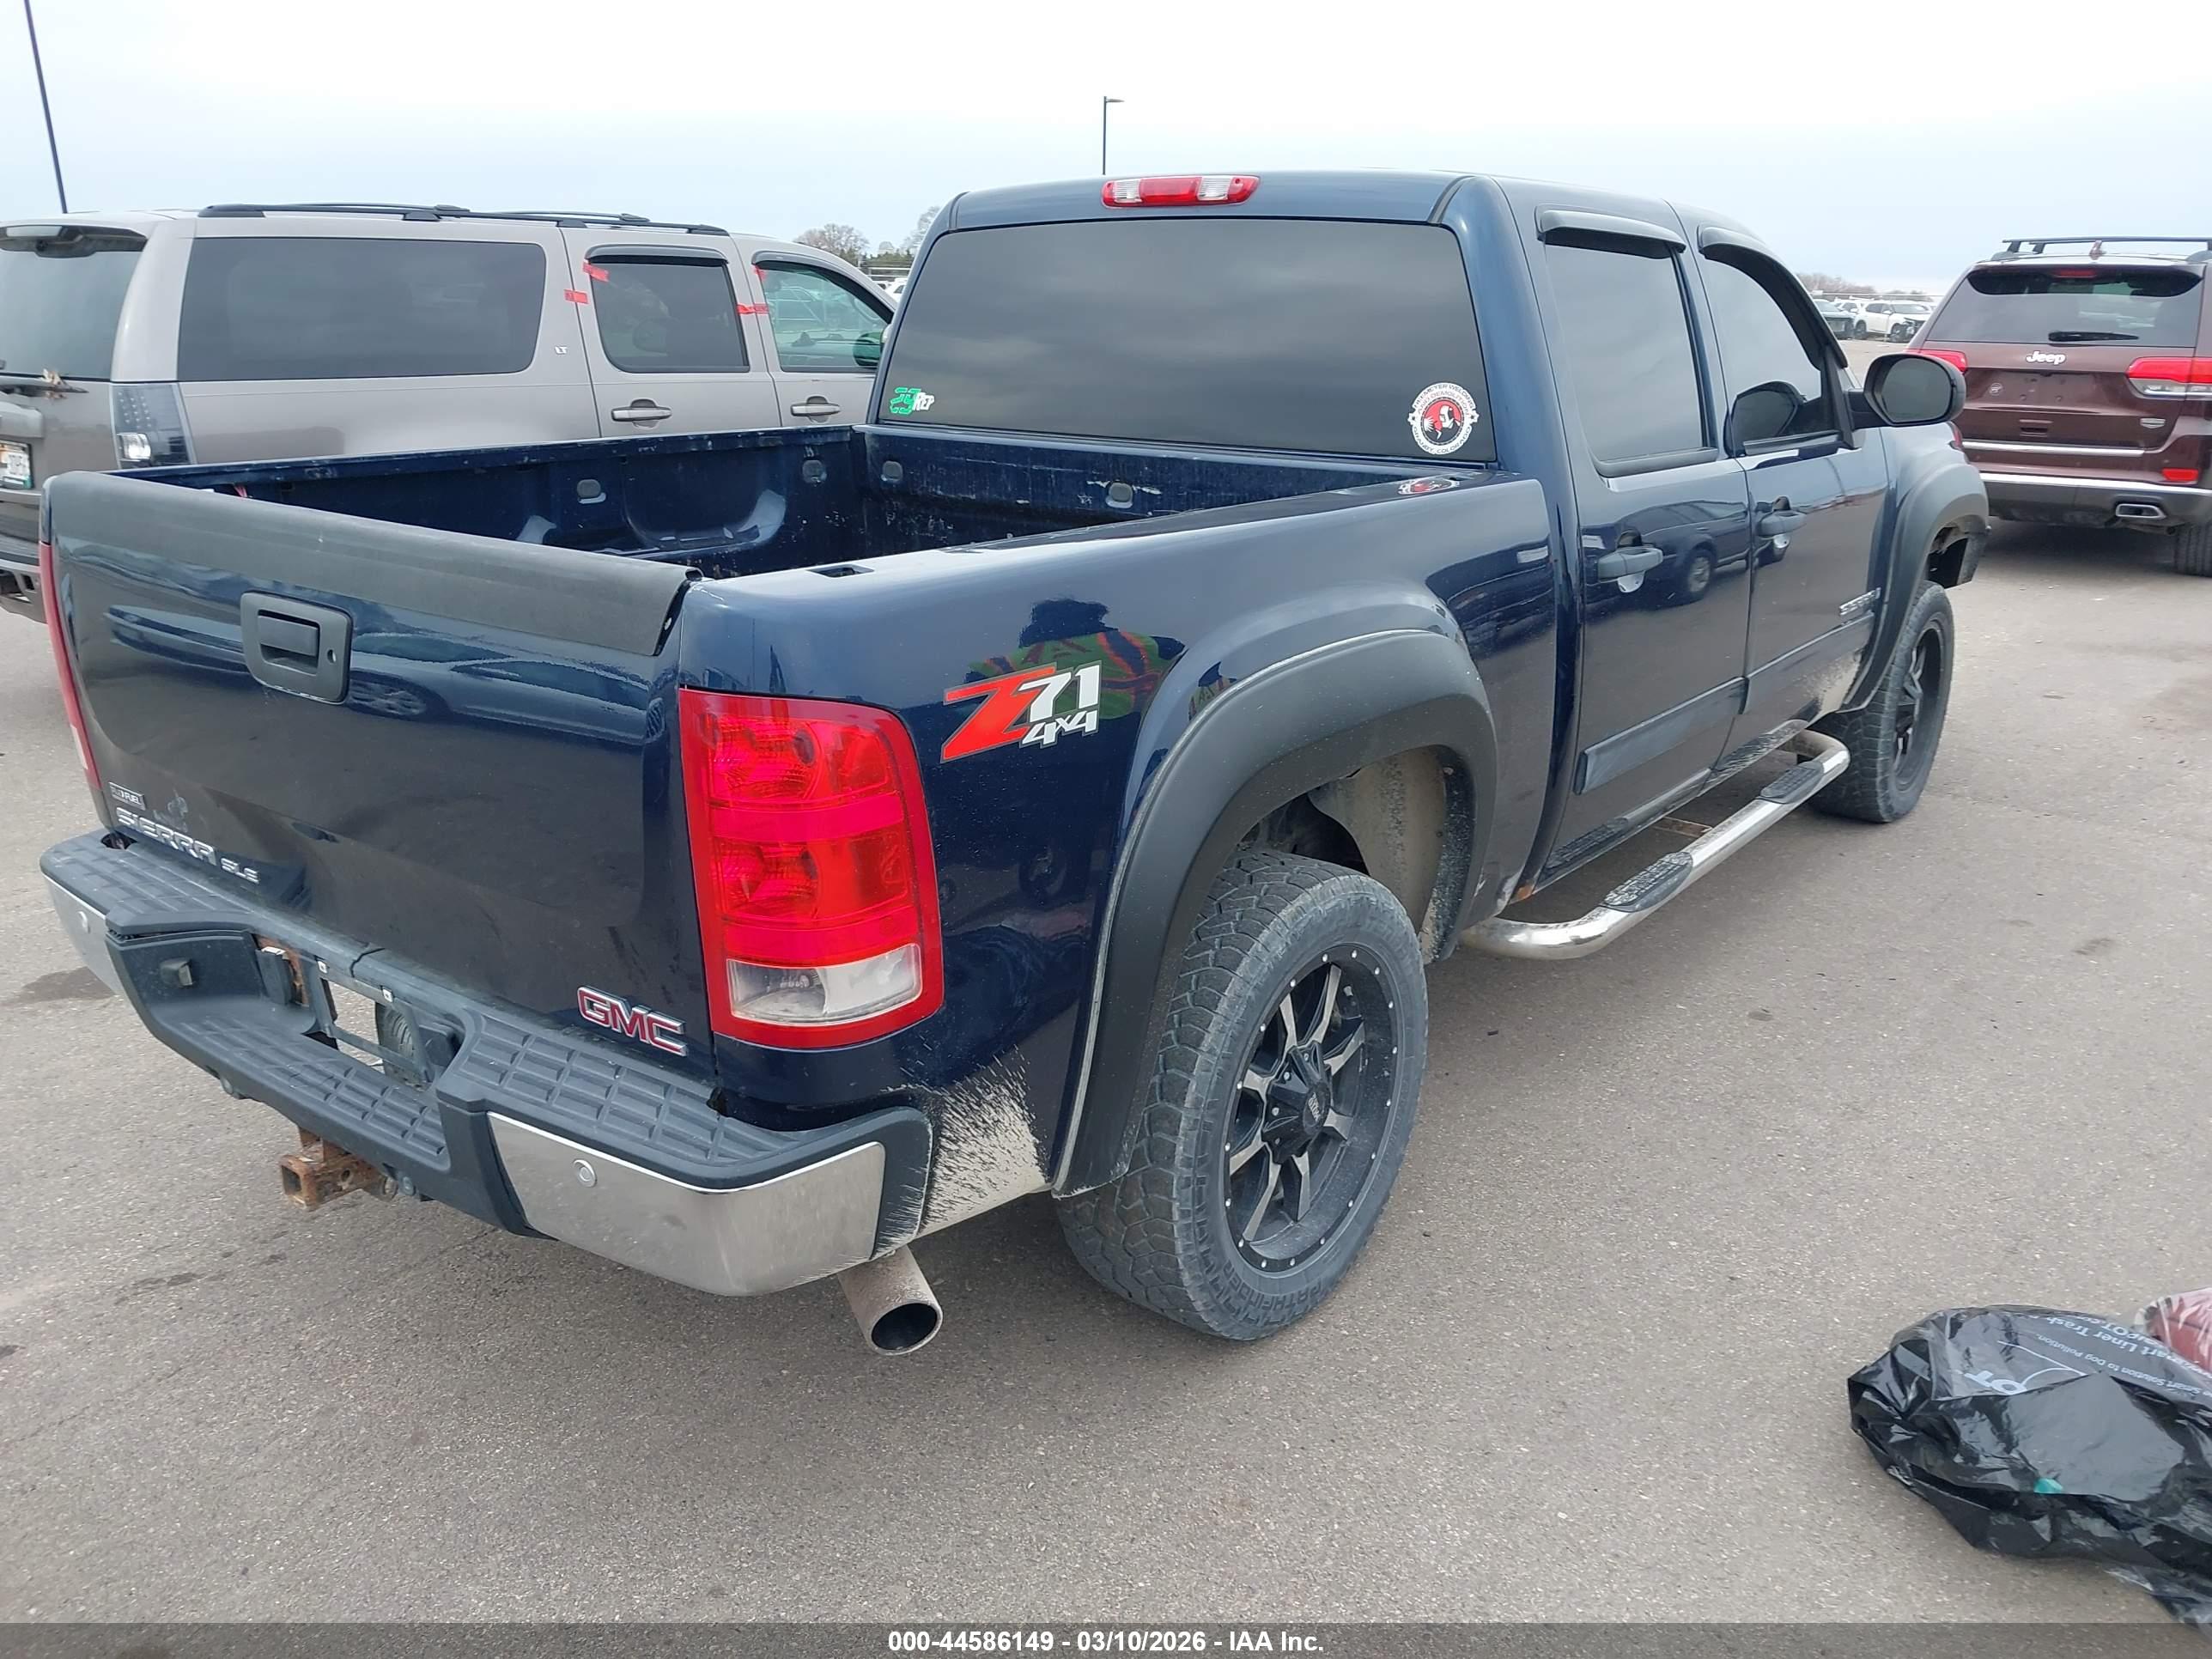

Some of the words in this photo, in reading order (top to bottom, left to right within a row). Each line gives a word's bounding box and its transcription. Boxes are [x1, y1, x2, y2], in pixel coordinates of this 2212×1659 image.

[2027, 350, 2066, 365] Jeep
[941, 659, 1103, 763] Z71
[116, 806, 217, 866] SIERRA
[220, 858, 259, 884] SLE
[577, 987, 687, 1057] GMC
[1222, 1258, 1322, 1312] PATHFINDER
[2045, 1316, 2090, 1338] Trash
[2093, 1331, 2139, 1353] Liner
[2084, 1353, 2106, 1366] Dog
[2106, 1363, 2122, 1372] to
[2121, 1366, 2166, 1387] Solution
[2166, 1379, 2202, 1395] Smart
